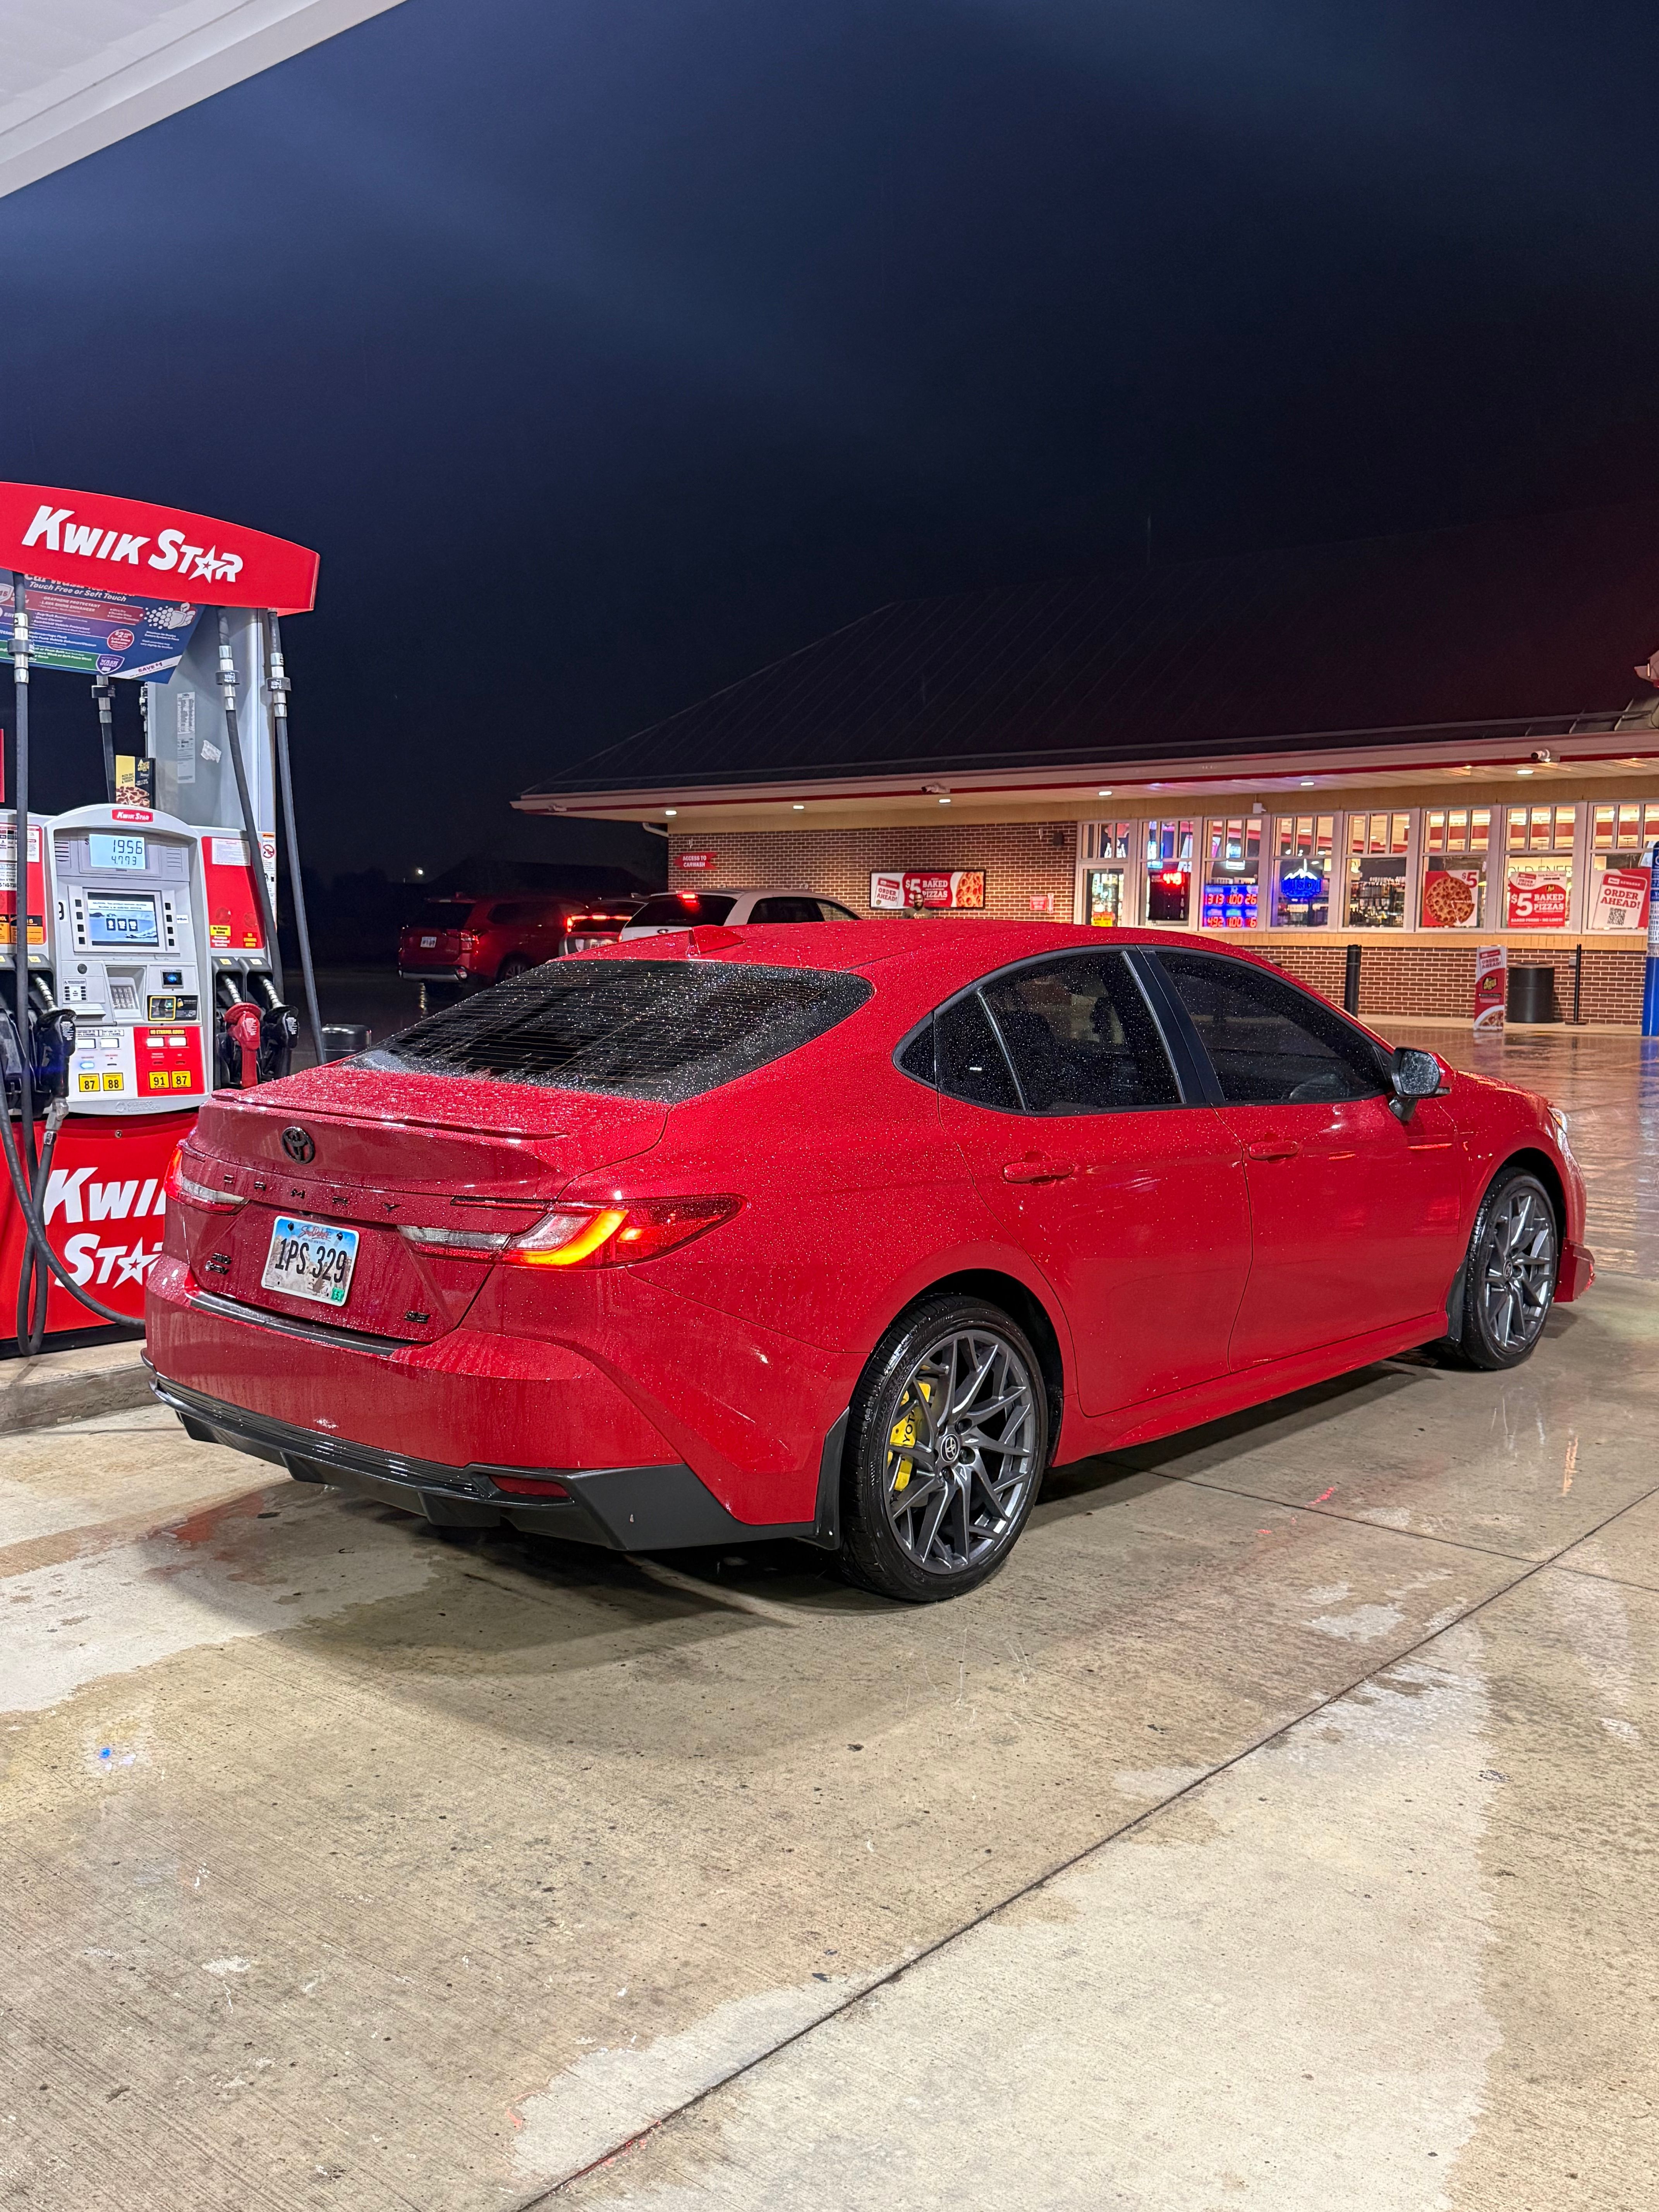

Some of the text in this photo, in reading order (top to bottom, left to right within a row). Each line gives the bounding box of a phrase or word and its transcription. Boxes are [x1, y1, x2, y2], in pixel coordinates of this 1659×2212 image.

[22, 505, 151, 565] KWIK
[29, 581, 53, 590] Touch
[84, 590, 102, 599] Soft
[103, 592, 127, 602] Touch
[1462, 871, 1477, 888] $5
[877, 893, 897, 902] AHEAD!
[878, 888, 896, 896] ORDER
[1604, 888, 1638, 900] ORDER
[1511, 893, 1533, 917] $5
[1600, 896, 1641, 909] AHEAD!
[84, 1080, 95, 1089] 87
[108, 1080, 119, 1089] 88
[153, 1077, 165, 1085] 91
[176, 1076, 187, 1085] 87
[275, 1238, 347, 1283] 1PS 329
